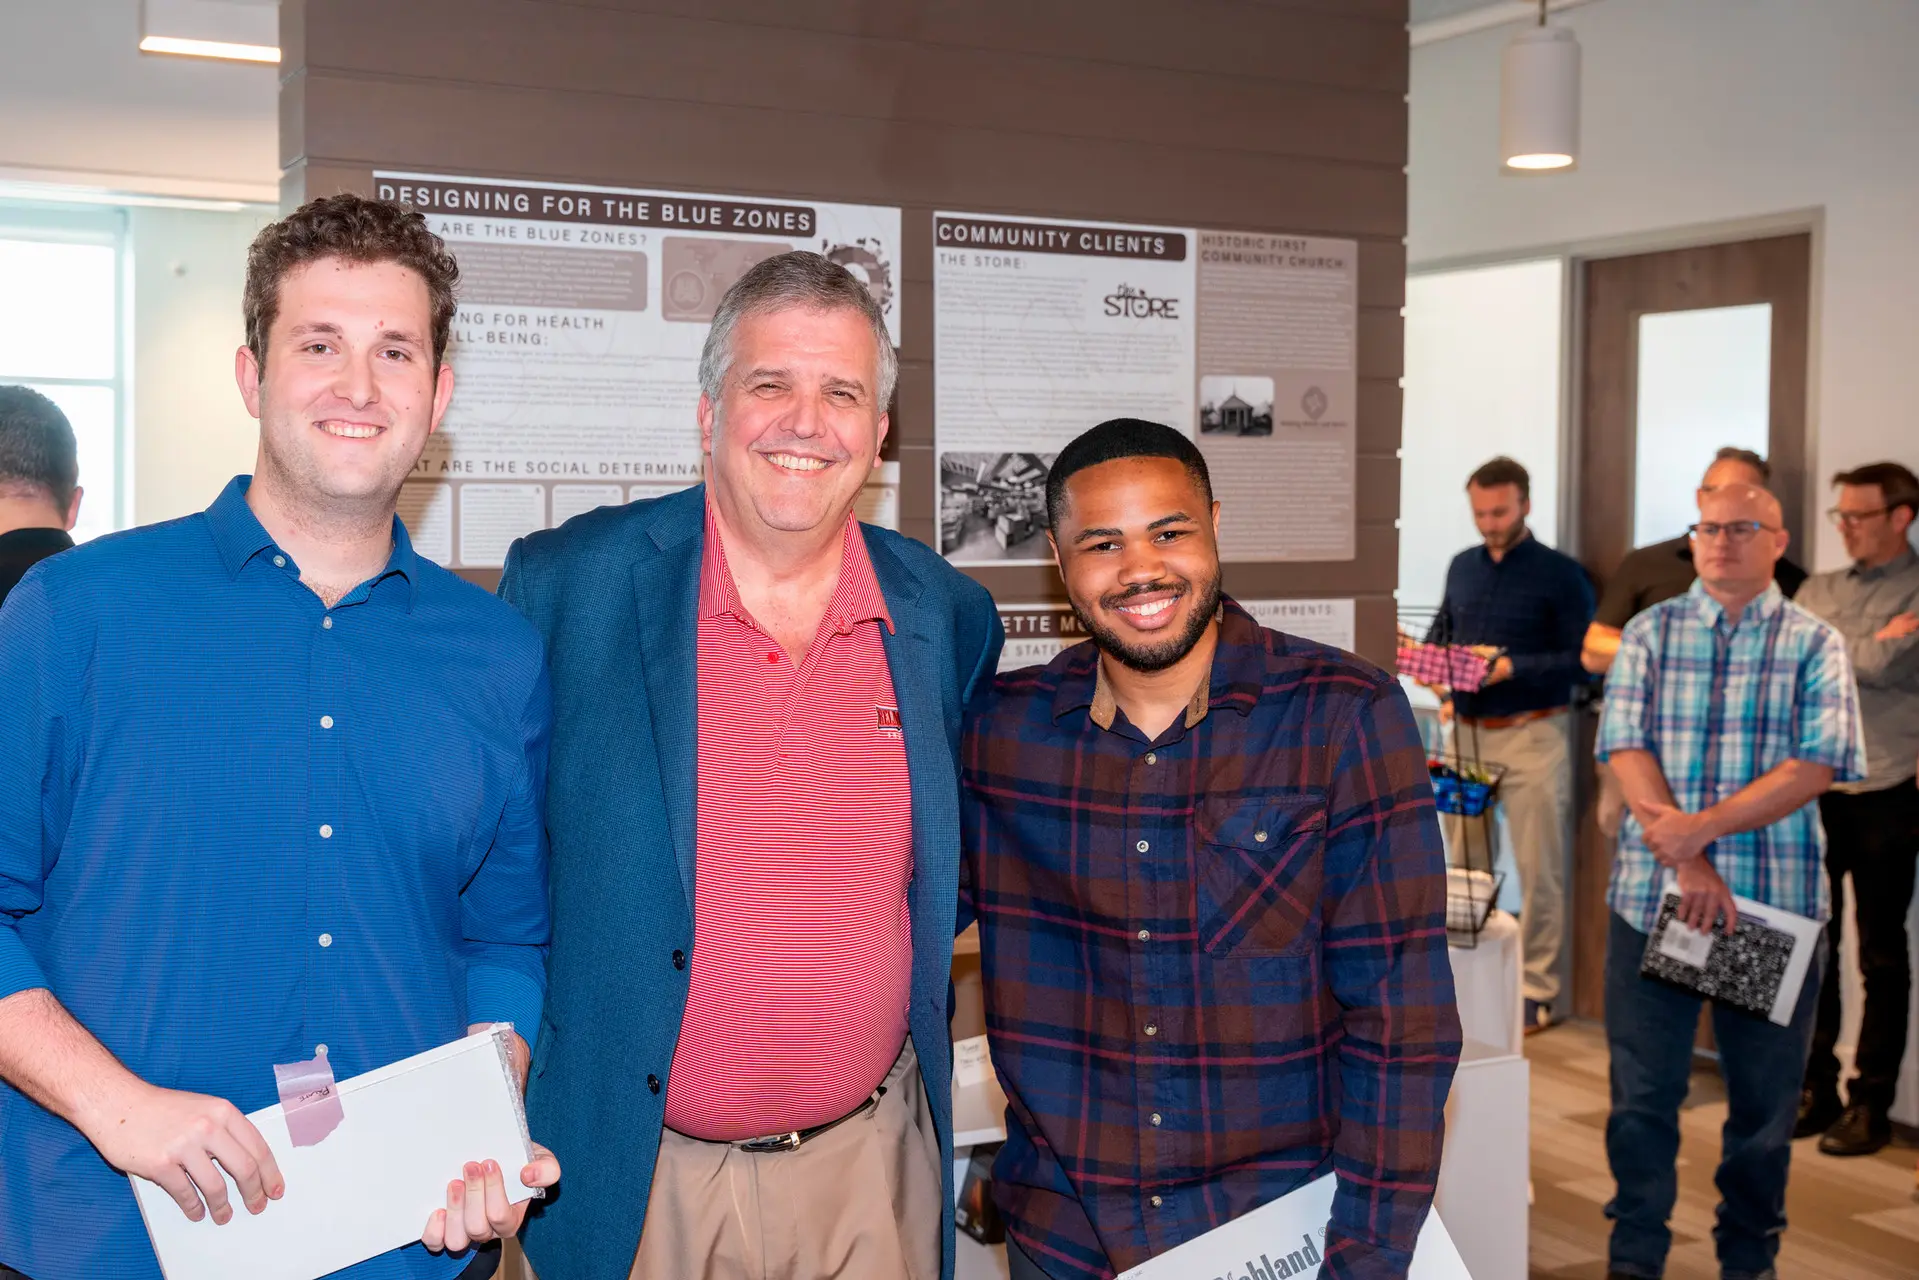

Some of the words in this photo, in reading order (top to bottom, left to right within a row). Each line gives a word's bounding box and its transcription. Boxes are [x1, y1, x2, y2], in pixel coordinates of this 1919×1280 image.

[379, 184, 530, 213] DESIGNING
[542, 195, 592, 217] FOR
[602, 199, 650, 220] THE
[661, 203, 722, 226] BLUE
[732, 208, 811, 232] ZONES
[440, 222, 475, 237] ARE
[484, 224, 518, 239] THE
[526, 228, 572, 243] BLUE
[579, 231, 648, 247] ZONES?
[938, 223, 1071, 249] COMMUNITY
[1080, 232, 1166, 256] CLIENTS
[1201, 235, 1267, 250] HISTORIC
[1270, 239, 1308, 253] FIRST
[938, 253, 967, 268] THE
[974, 255, 1027, 270] STORE:
[1201, 249, 1286, 266] COMMUNITY
[1102, 294, 1180, 319] STORE
[493, 313, 528, 328] FOR
[536, 315, 605, 331] HEALTH
[440, 460, 475, 474] ARE
[484, 461, 518, 475] THE
[525, 461, 591, 476] SOCIAL
